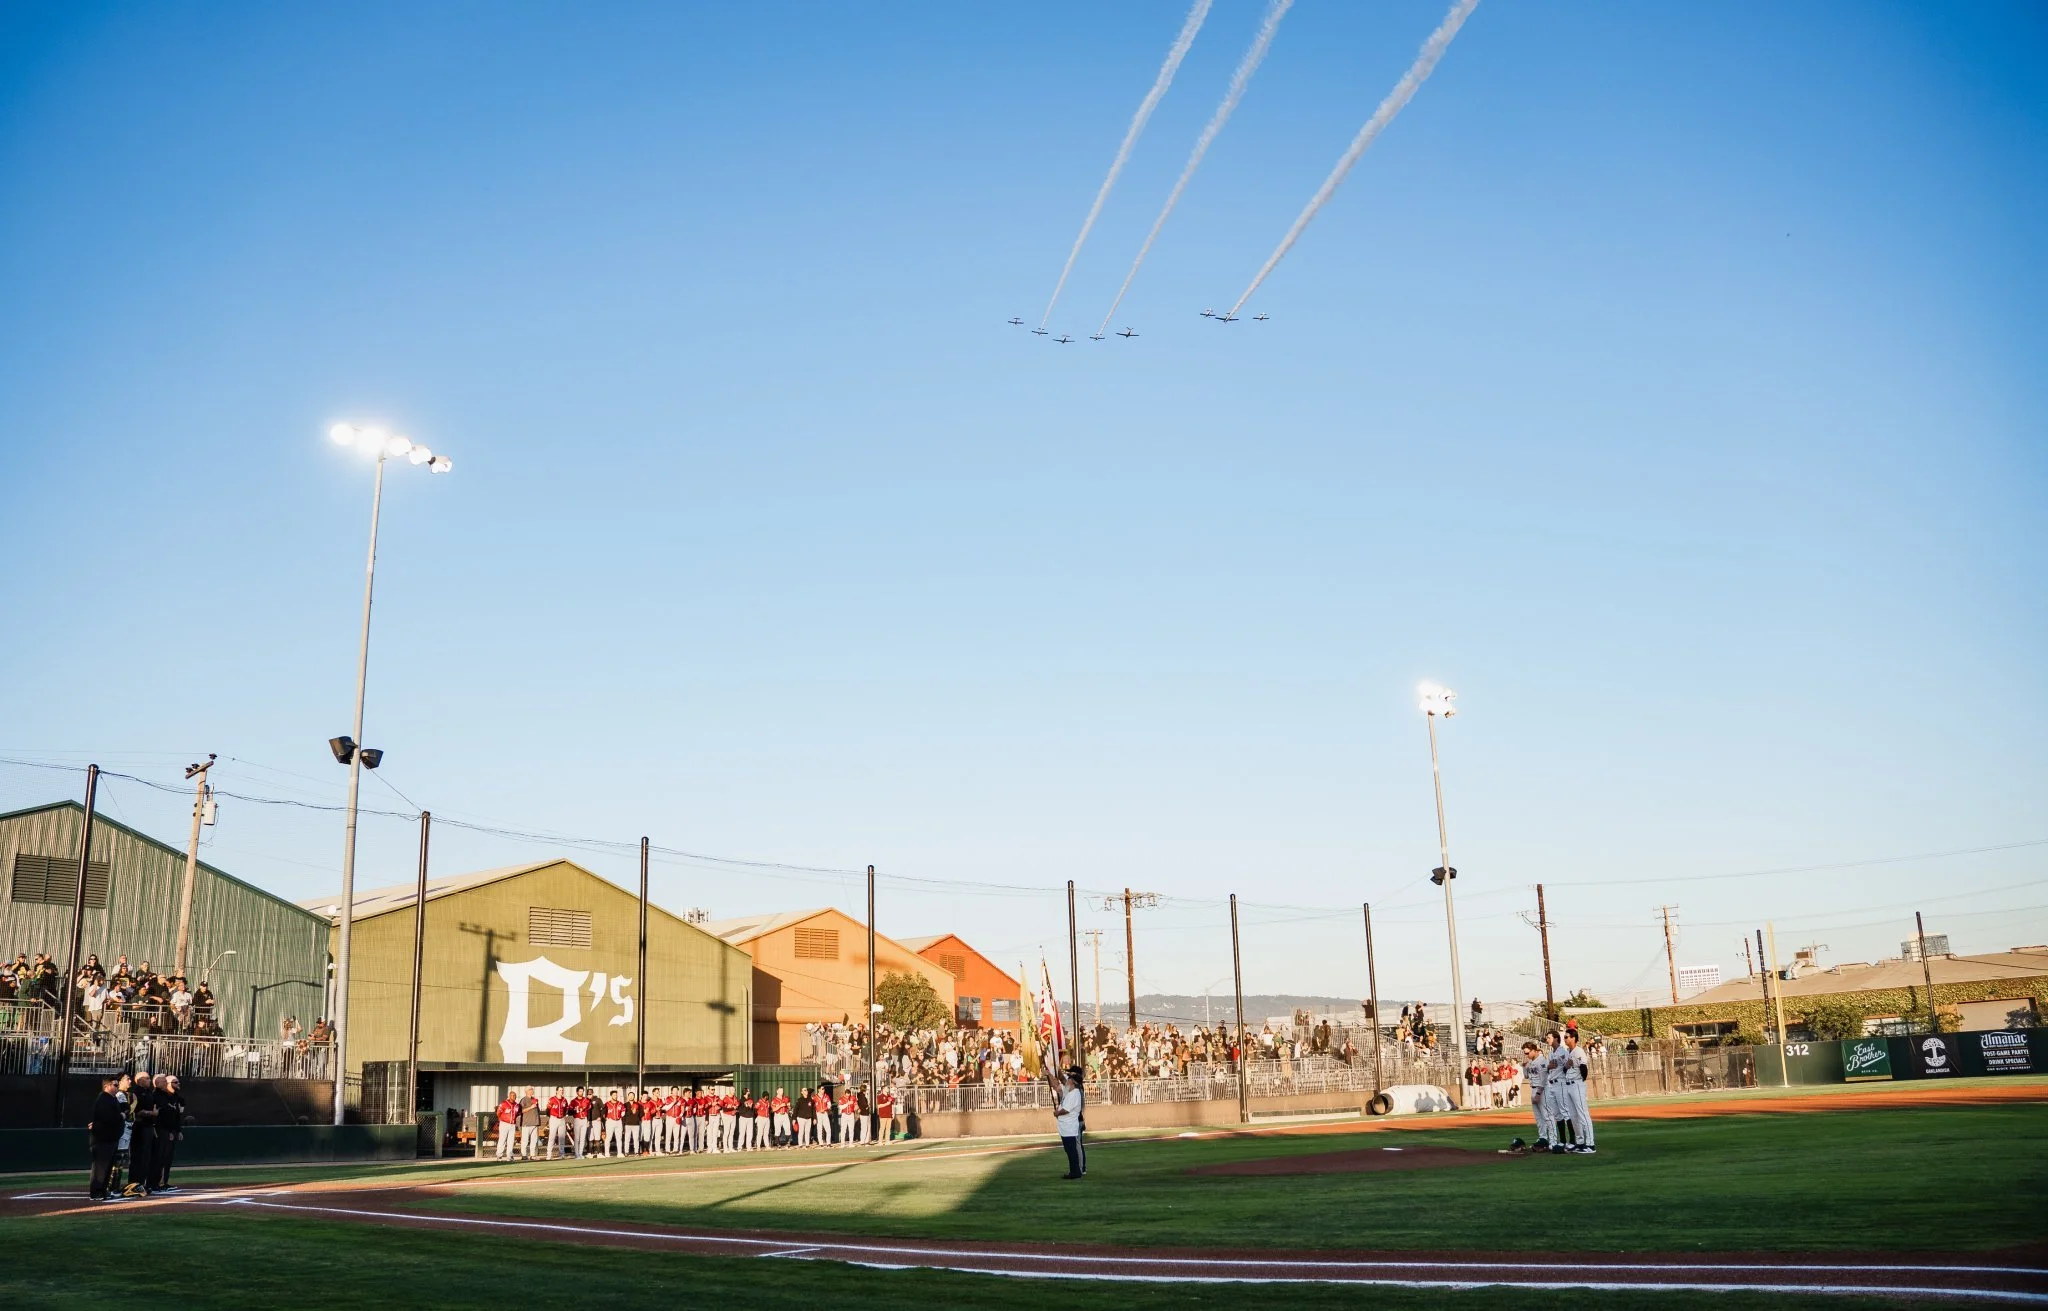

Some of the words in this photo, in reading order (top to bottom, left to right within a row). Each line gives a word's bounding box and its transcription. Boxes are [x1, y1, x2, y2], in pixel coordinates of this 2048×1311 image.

[1980, 1032, 2027, 1048] Almanac
[1786, 1044, 1809, 1056] 312
[1854, 1043, 1875, 1055] East
[1847, 1050, 1885, 1071] Brother
